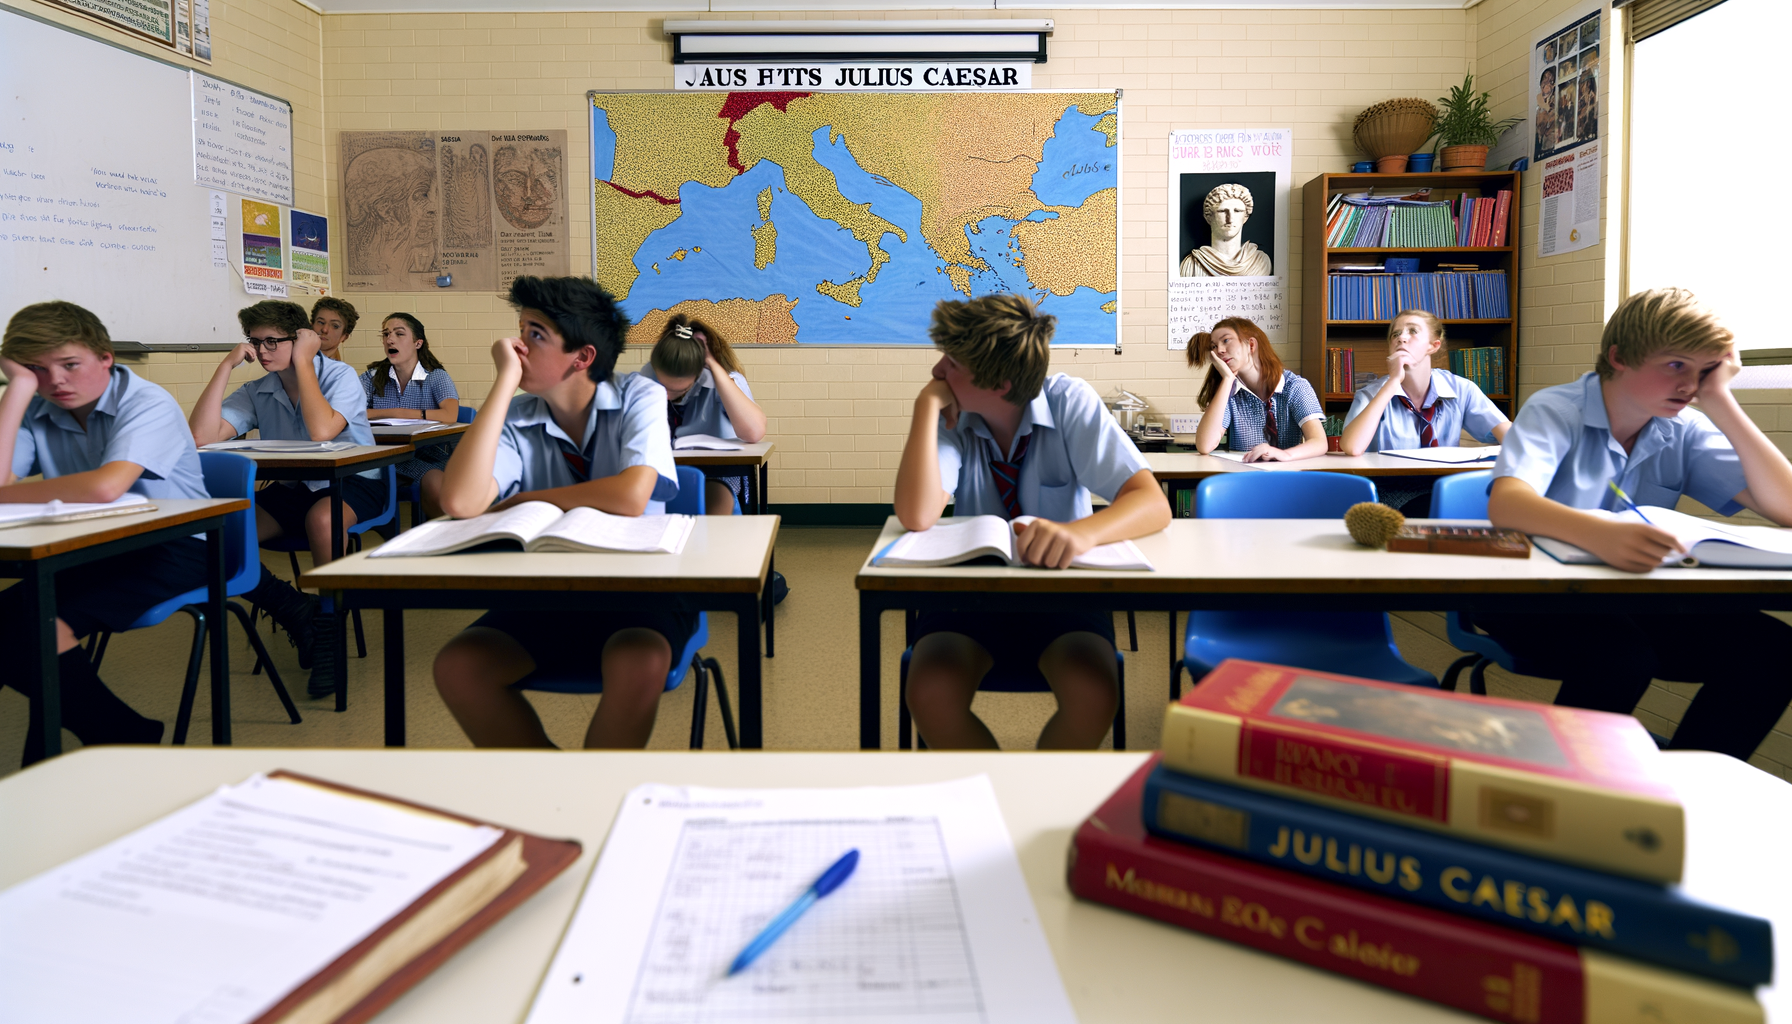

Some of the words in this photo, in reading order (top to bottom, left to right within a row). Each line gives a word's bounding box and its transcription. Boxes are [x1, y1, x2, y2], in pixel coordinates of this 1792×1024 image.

[835, 67, 913, 86] JULIUS
[923, 66, 1019, 87] CAESAR
[1268, 825, 1424, 892] JULIUS
[1439, 866, 1617, 940] CAESAR
